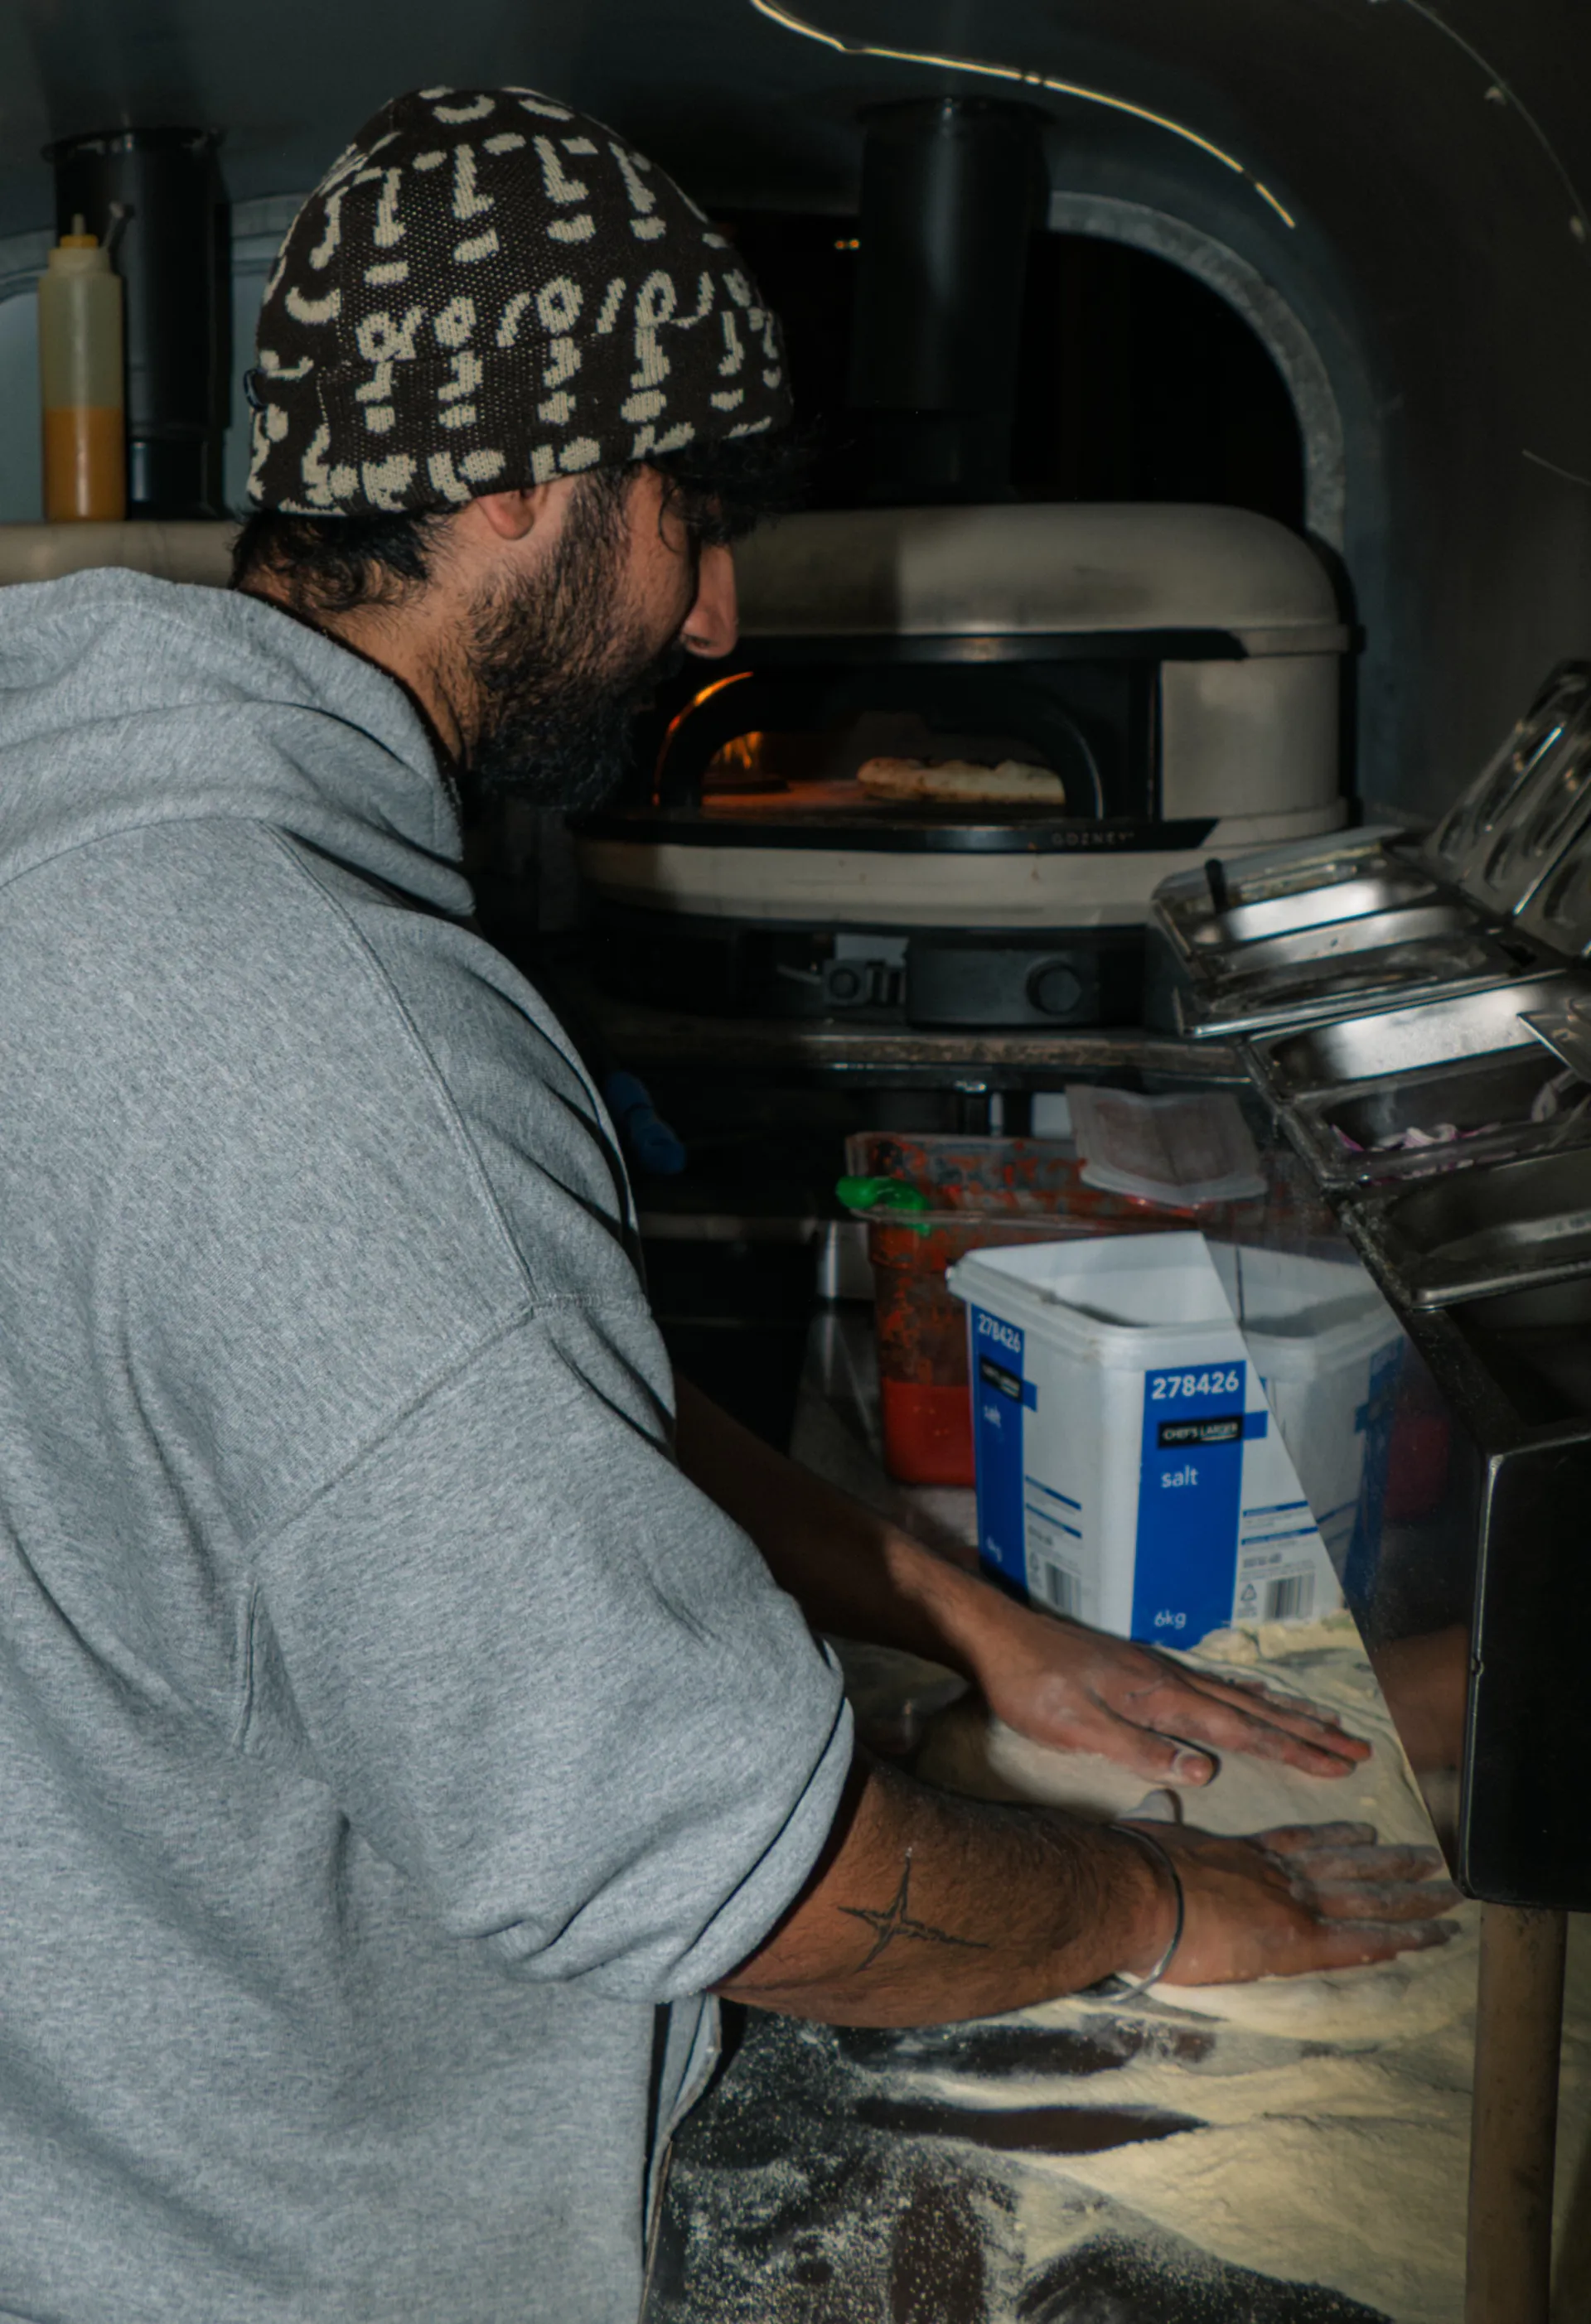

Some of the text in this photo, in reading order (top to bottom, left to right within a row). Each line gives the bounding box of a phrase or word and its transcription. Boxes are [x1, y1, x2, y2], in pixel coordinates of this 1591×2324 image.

[1152, 1370, 1240, 1400] 278426
[1162, 1464, 1198, 1488] salt
[1154, 1609, 1187, 1631] 6kg
